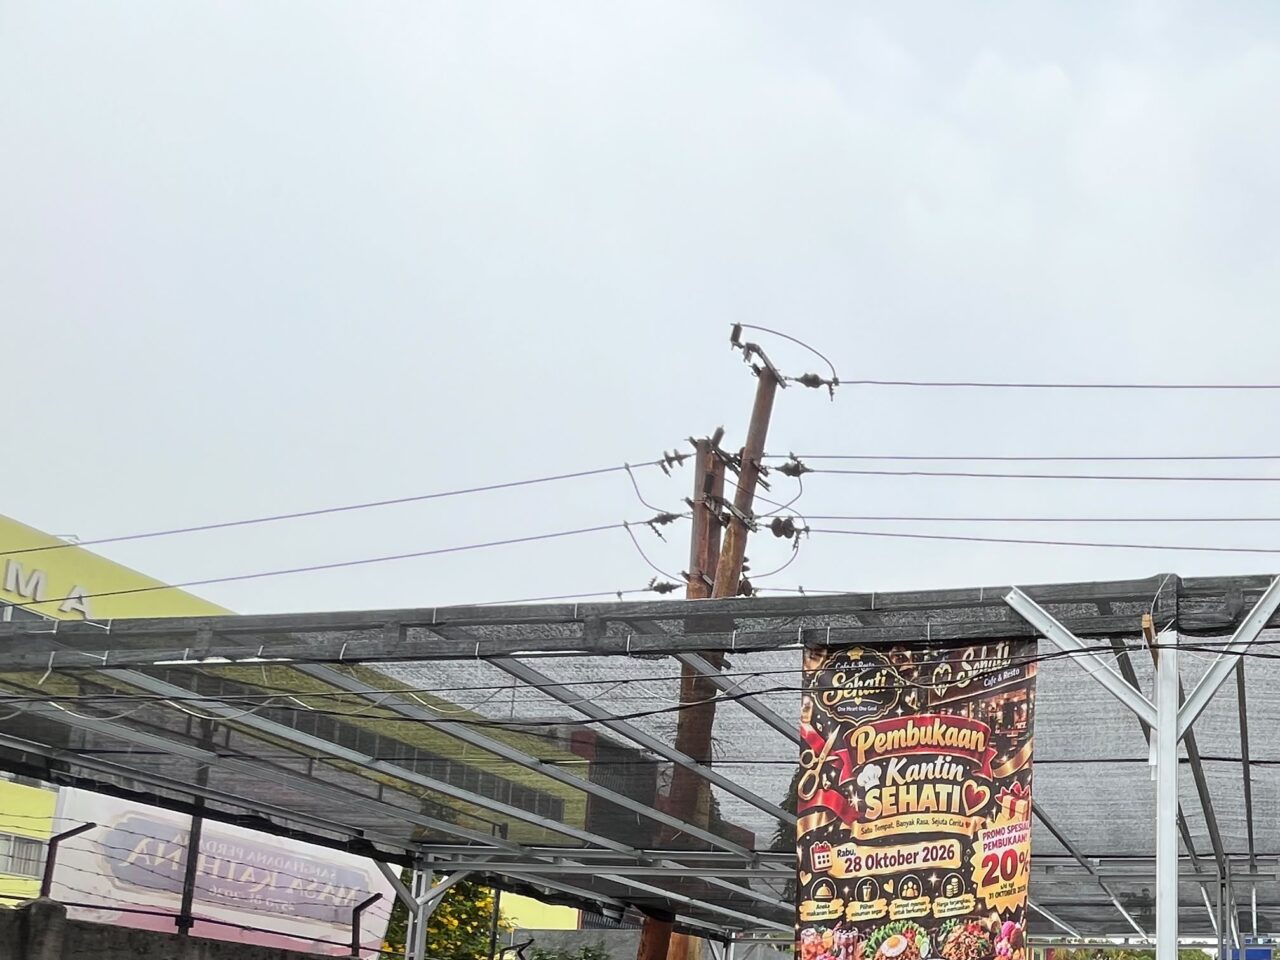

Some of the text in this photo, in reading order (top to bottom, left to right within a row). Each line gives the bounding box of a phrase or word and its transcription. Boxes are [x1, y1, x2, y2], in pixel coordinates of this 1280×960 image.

[822, 669, 887, 705] Sehati
[1003, 667, 1020, 679] Resto
[850, 718, 986, 764] Pembukaan
[885, 755, 965, 786] Kantin
[864, 783, 961, 820] SEHATI
[896, 819, 915, 829] Banyak
[931, 818, 948, 827] Sejuta
[948, 819, 964, 828] Cerita
[982, 827, 1006, 841] PROMO
[837, 849, 856, 858] Rabu,
[844, 844, 955, 874] 28 Oktober 2026
[981, 848, 1030, 888] 20%
